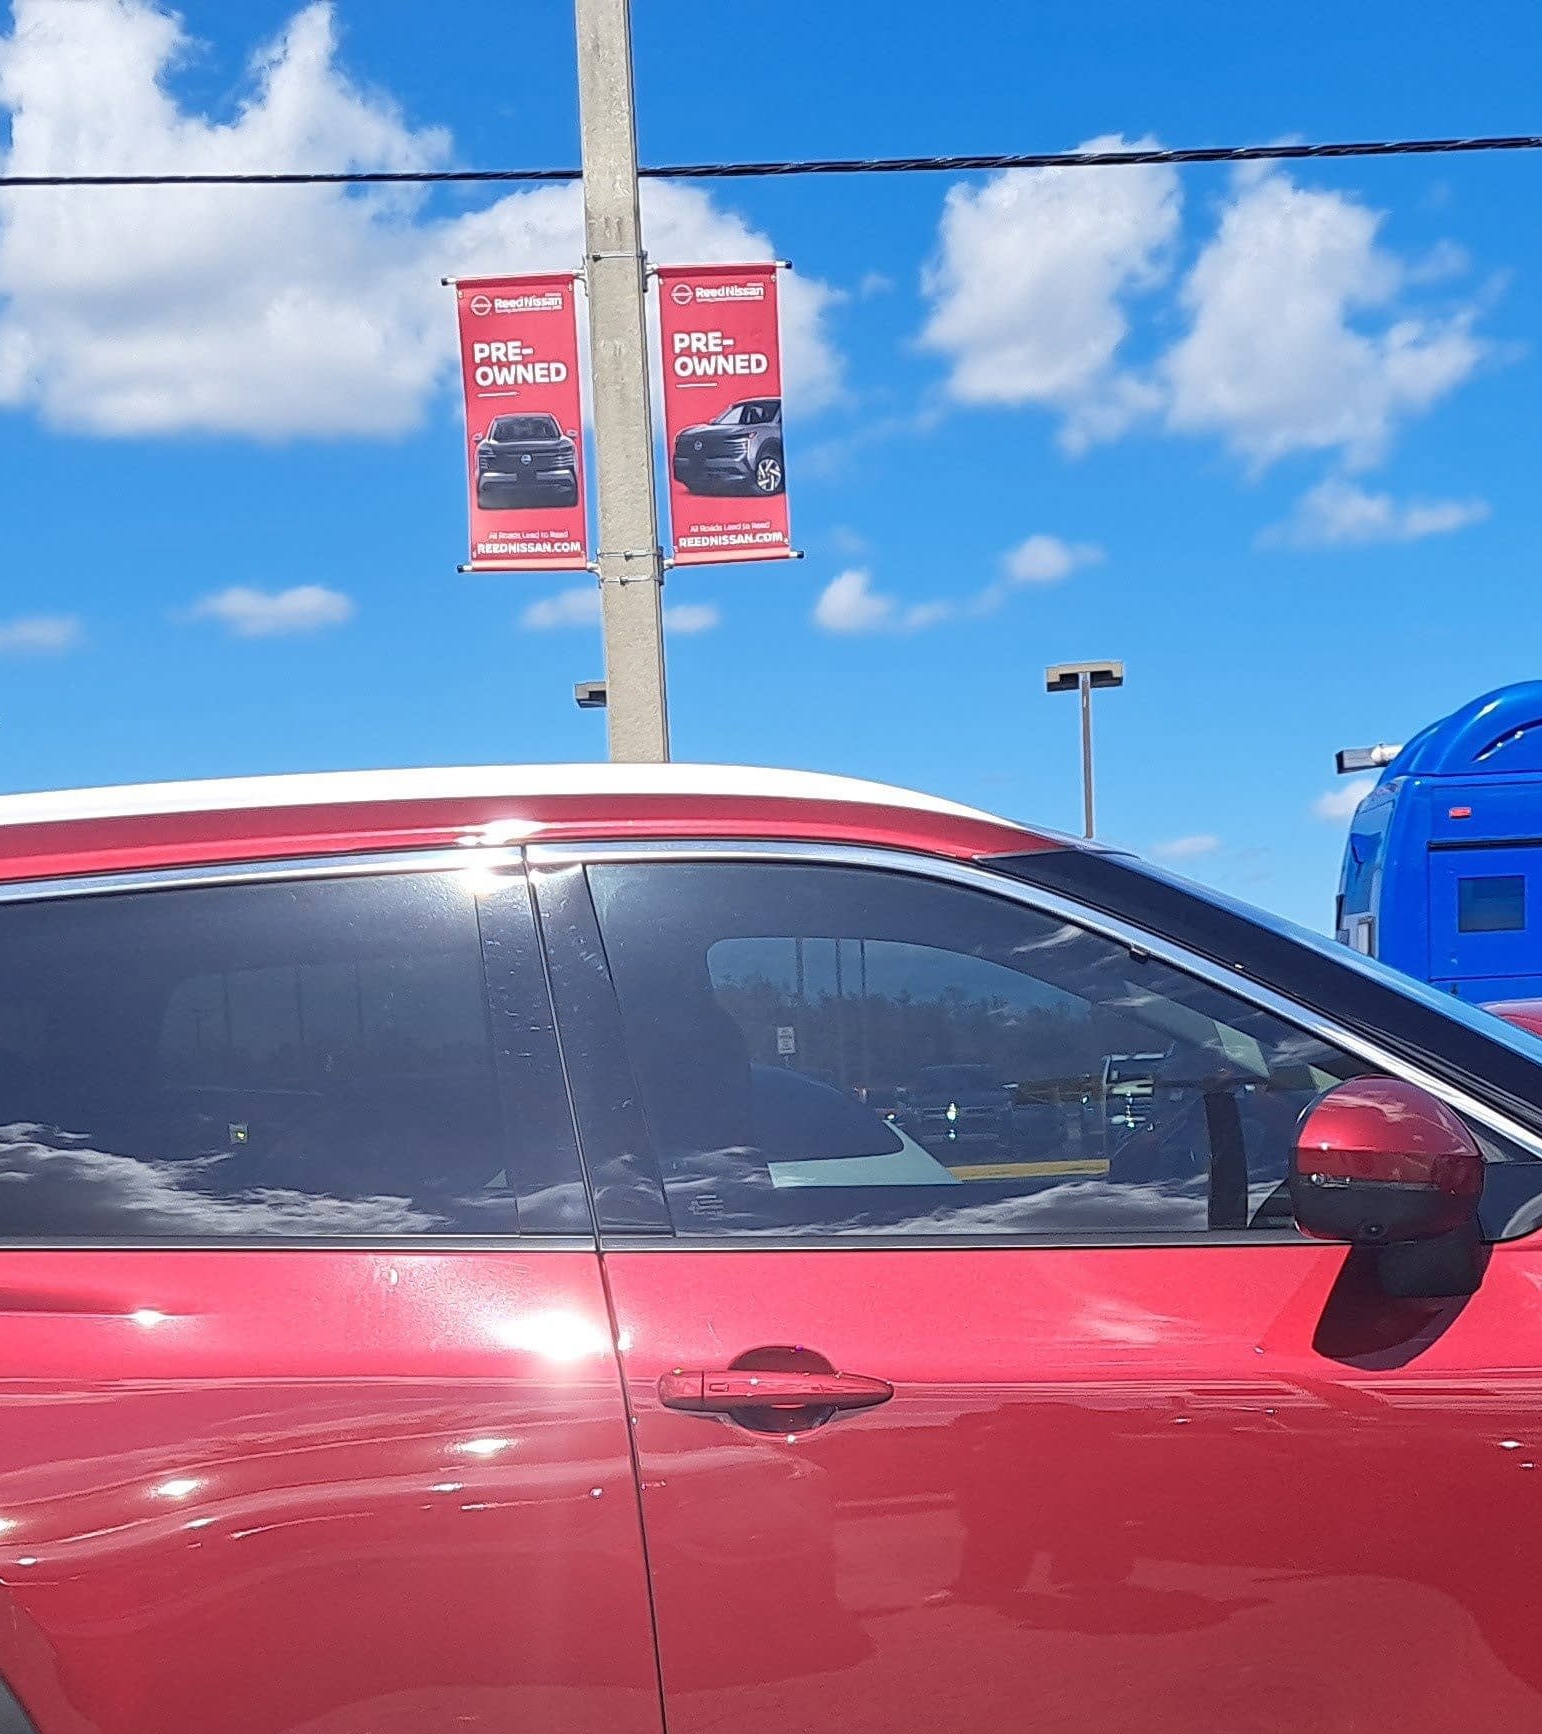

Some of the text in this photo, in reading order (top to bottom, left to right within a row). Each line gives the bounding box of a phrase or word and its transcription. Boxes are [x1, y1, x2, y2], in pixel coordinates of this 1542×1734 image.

[695, 286, 725, 297] Reed
[726, 285, 764, 296] Nissan
[494, 297, 524, 308] Reed
[524, 296, 562, 307] Nissan
[673, 331, 734, 353] PRE-
[473, 341, 534, 363] PRE-
[674, 353, 768, 377] OWNED
[475, 362, 567, 387] OWNED
[477, 542, 581, 554] REEDNISSAN.COM
[679, 532, 783, 547] REEDNISSAN.COM
